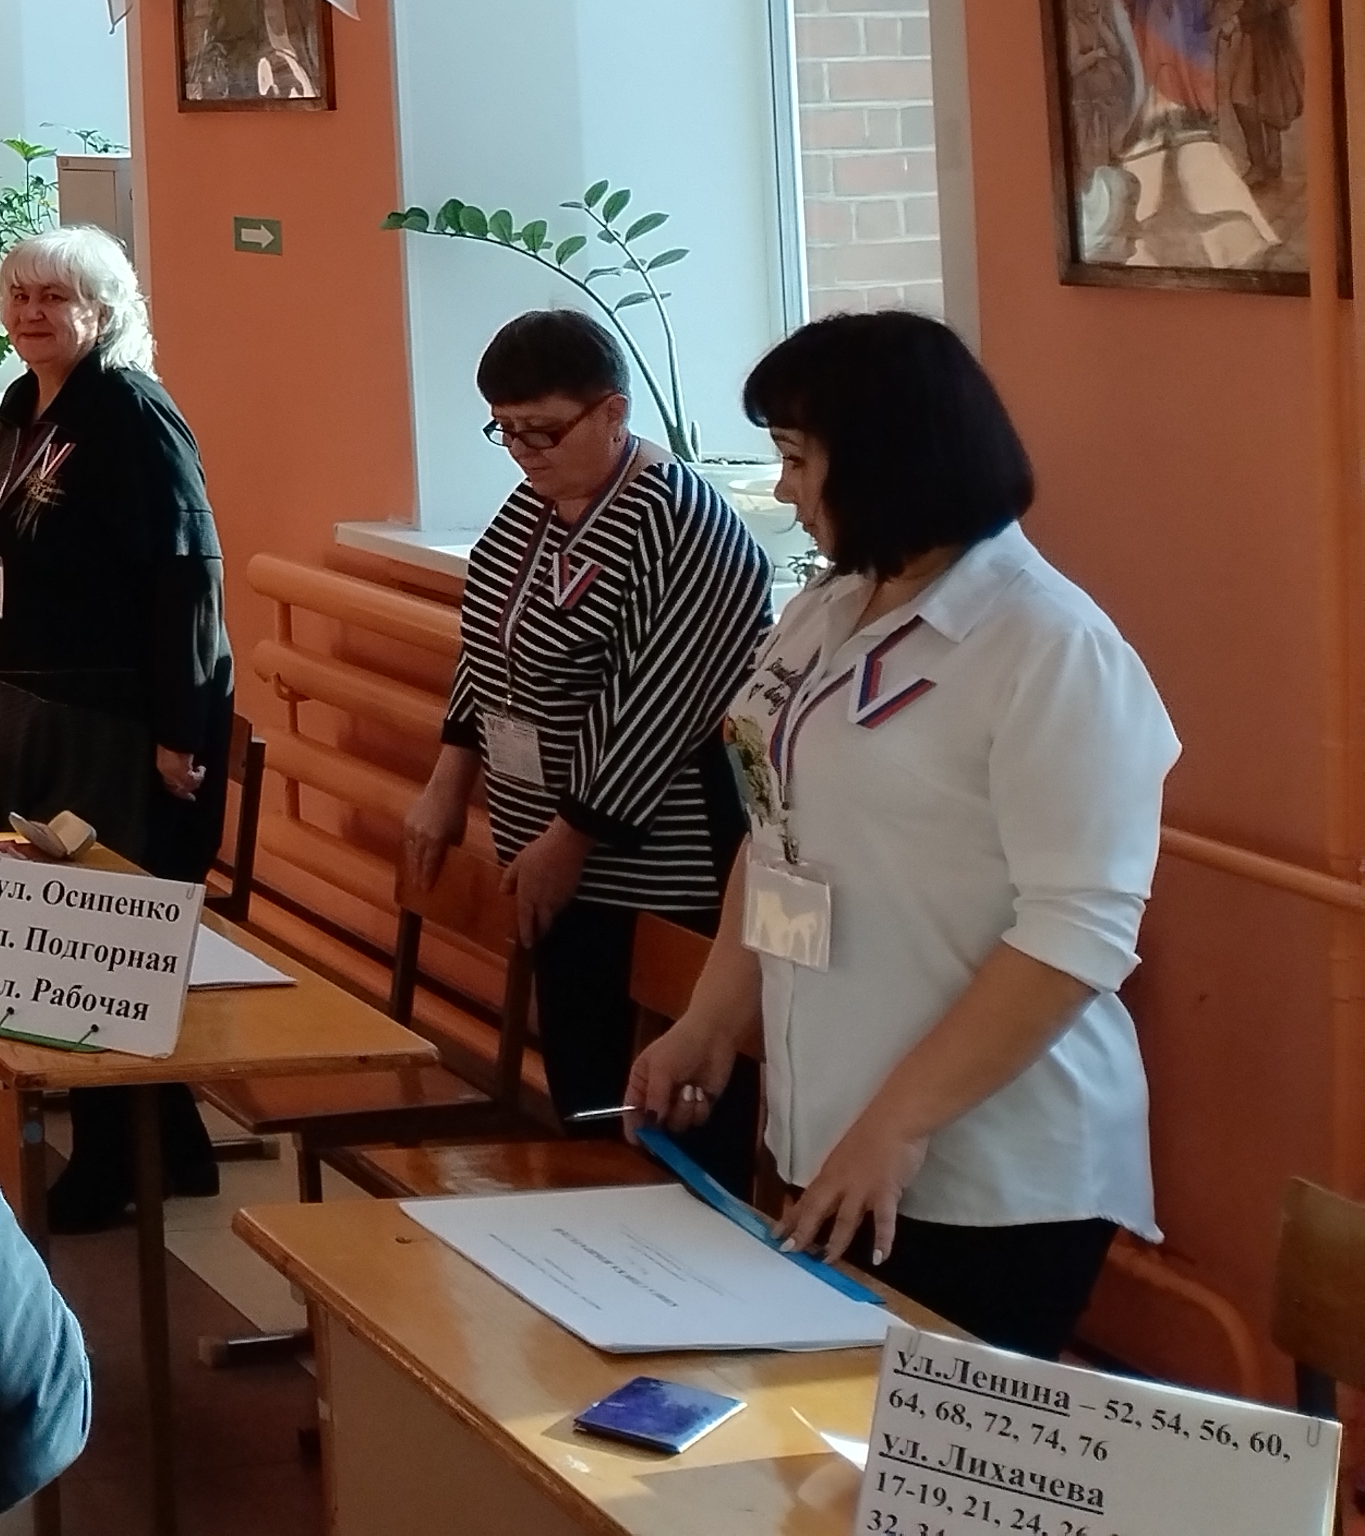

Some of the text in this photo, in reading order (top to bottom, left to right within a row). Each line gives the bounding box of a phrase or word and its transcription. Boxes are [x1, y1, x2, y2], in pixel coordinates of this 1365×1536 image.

[42, 879, 180, 923] Осипенко
[24, 926, 178, 974] Подгорная
[29, 977, 149, 1021] Рабочая
[889, 1388, 1111, 1462] 64, 68, 72, 74, 76
[896, 1350, 1071, 1409] ул.Ленина
[1104, 1399, 1142, 1430] 52,
[1151, 1409, 1190, 1439] 54,
[1199, 1419, 1239, 1451] 56,
[1249, 1431, 1291, 1463] 60,
[882, 1433, 1104, 1508] ул. Лихачева
[875, 1471, 954, 1514] 17-19,
[962, 1495, 1001, 1528] 21,
